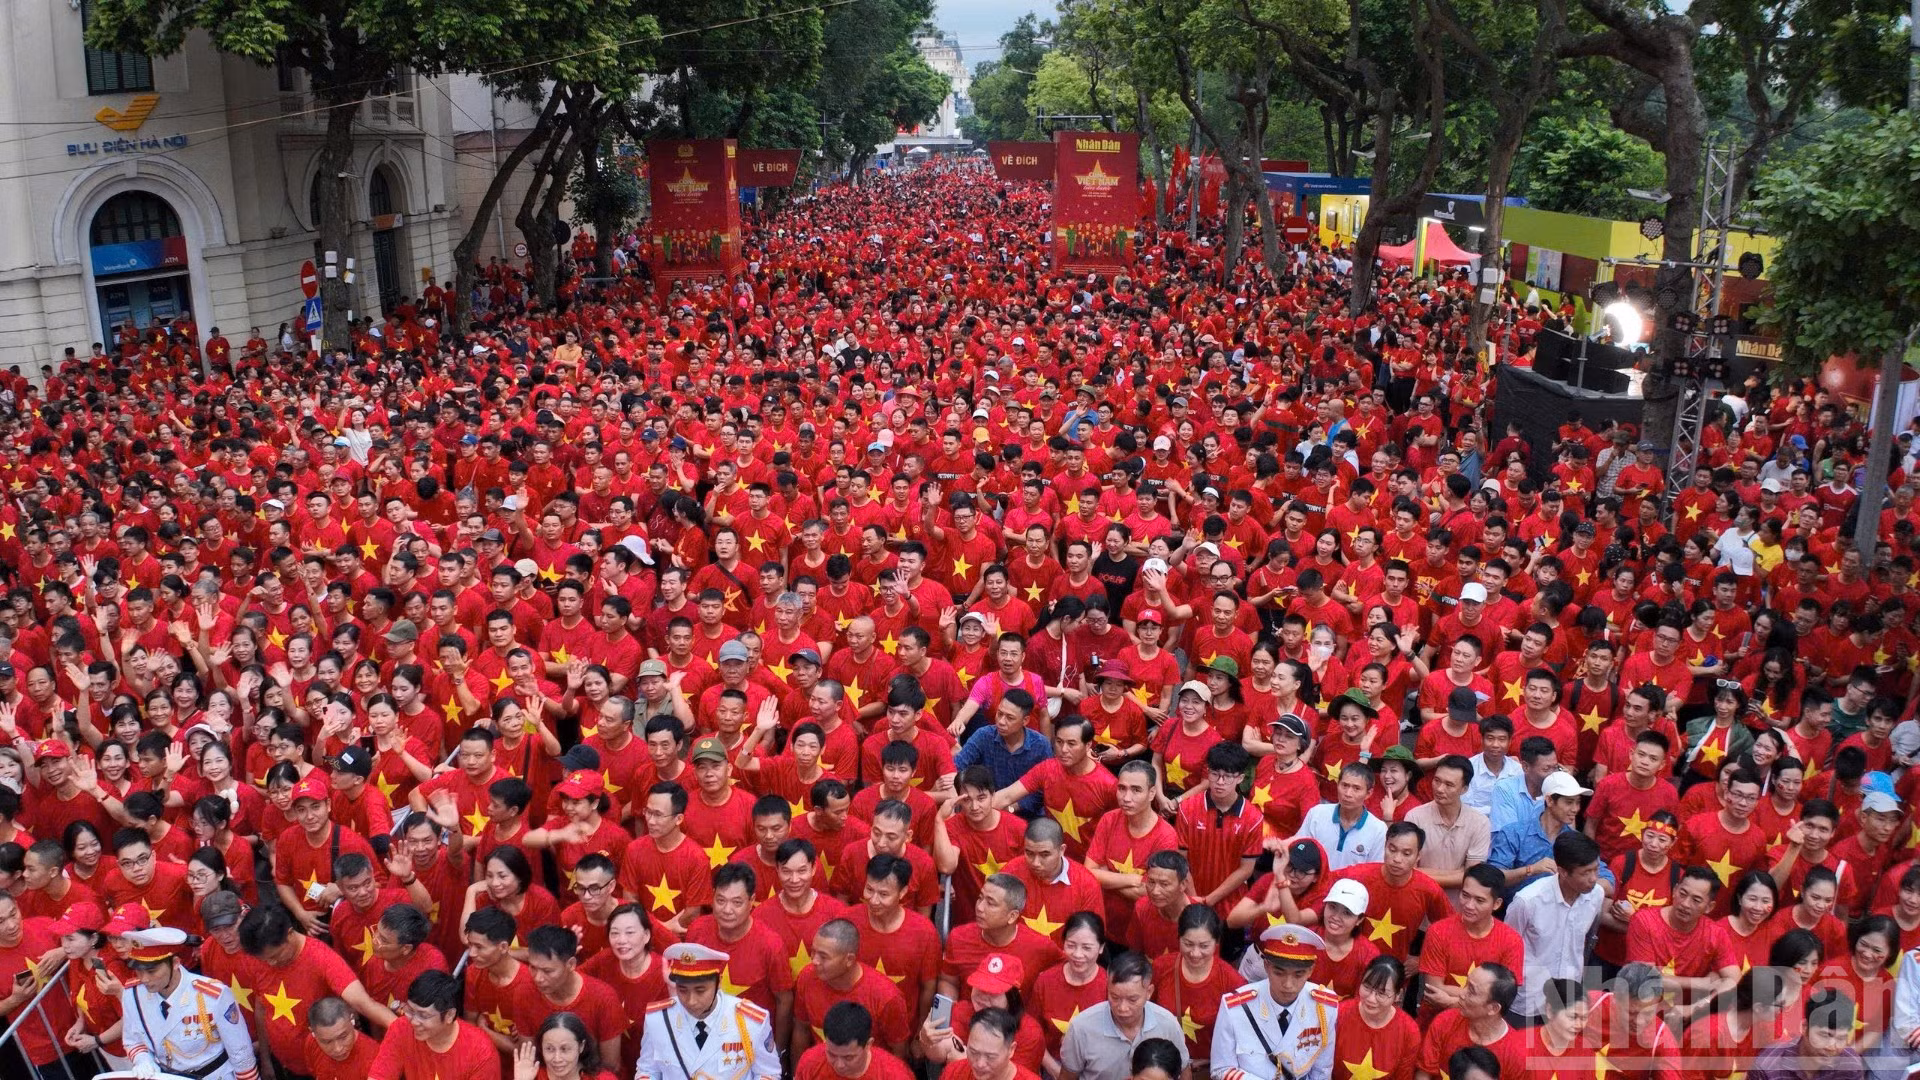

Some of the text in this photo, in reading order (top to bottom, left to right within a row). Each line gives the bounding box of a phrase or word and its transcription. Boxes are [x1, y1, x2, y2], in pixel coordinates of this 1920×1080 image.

[1076, 139, 1121, 151] Nhân Dân
[1016, 154, 1038, 165] ĐÍCH
[766, 161, 788, 172] ĐÍCH
[1736, 339, 1767, 356] Nhân
